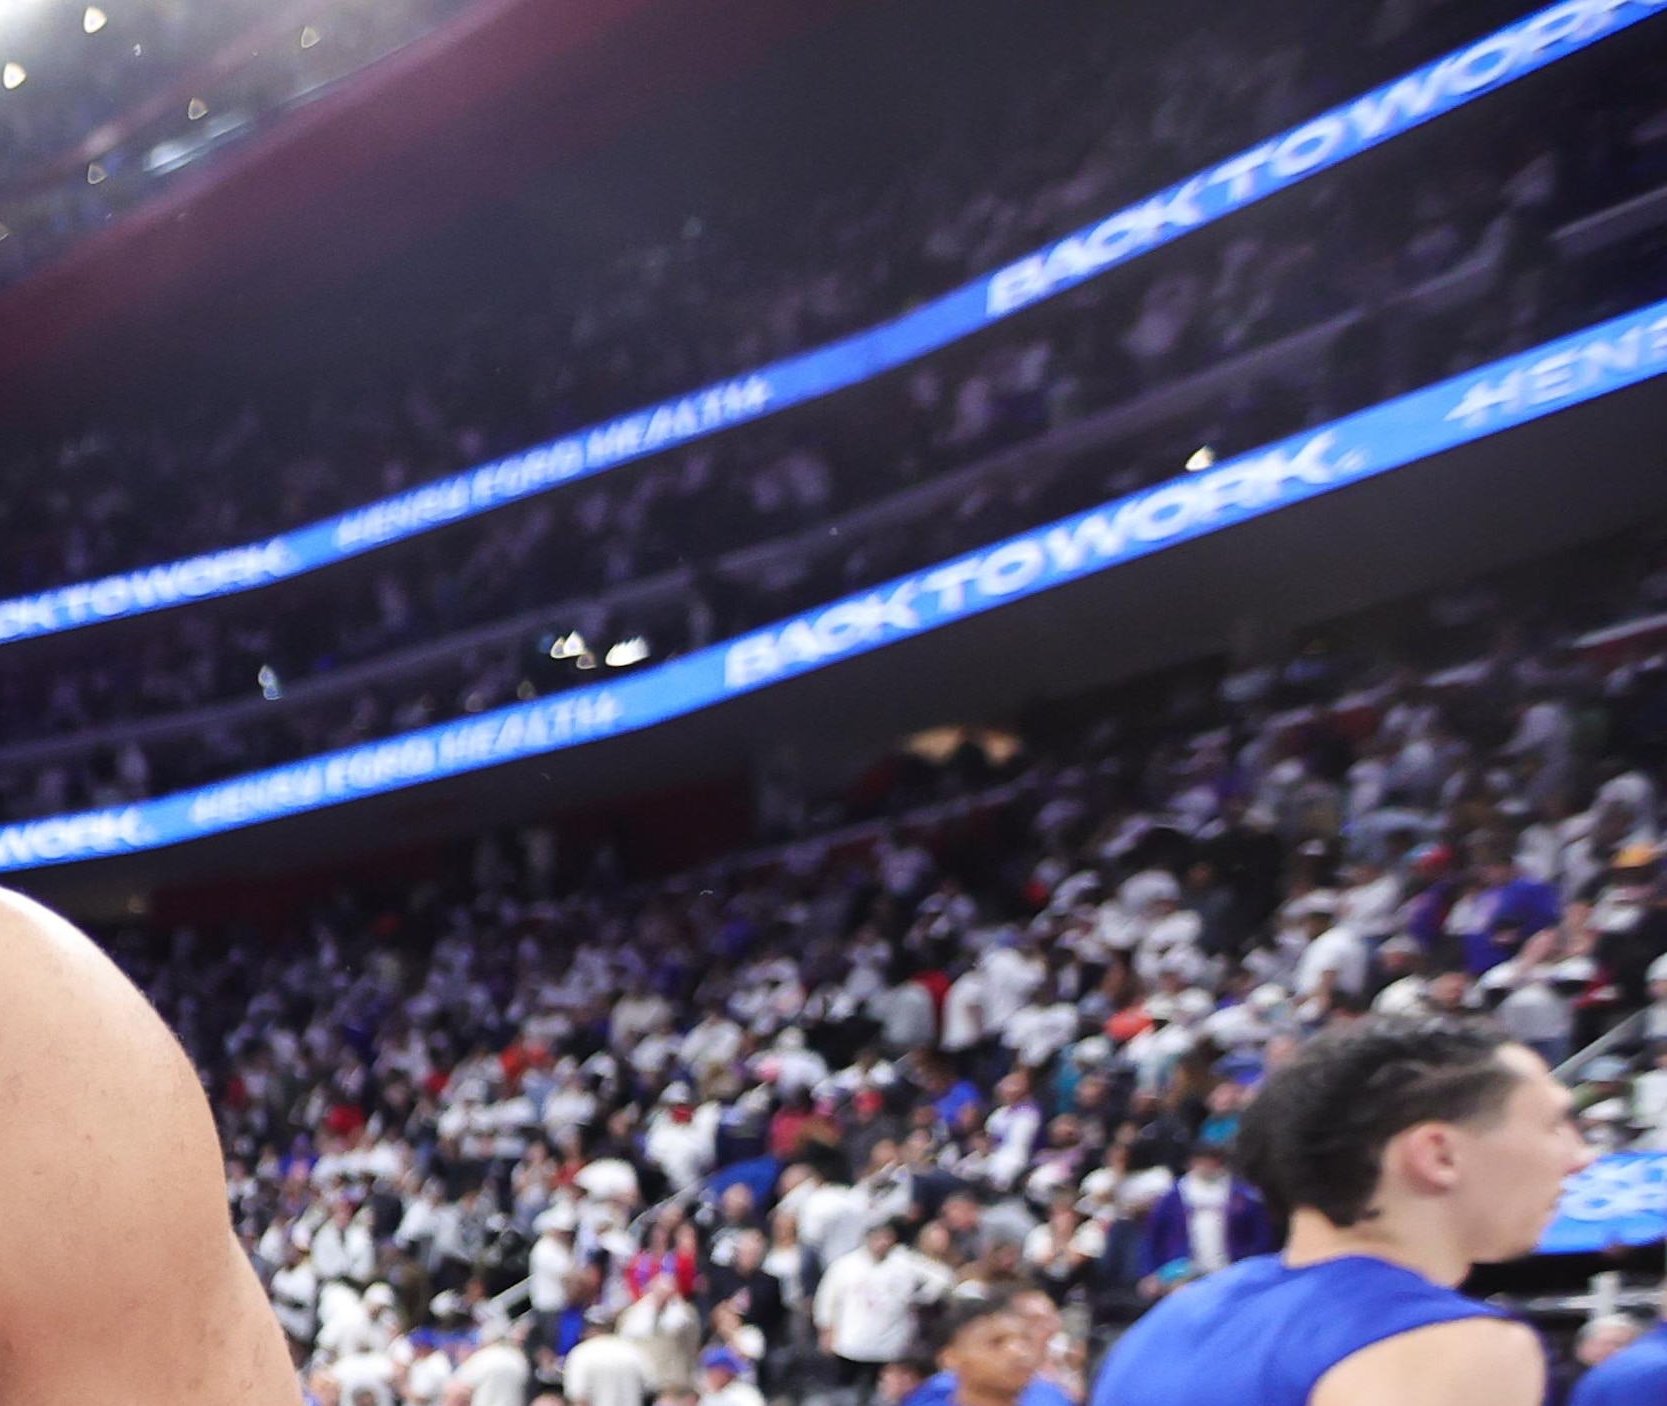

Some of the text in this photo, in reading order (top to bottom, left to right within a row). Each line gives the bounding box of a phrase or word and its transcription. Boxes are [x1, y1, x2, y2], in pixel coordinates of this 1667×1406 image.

[986, 0, 1665, 318] BACK TO WOR
[723, 428, 1337, 688] BACK TO WORK
